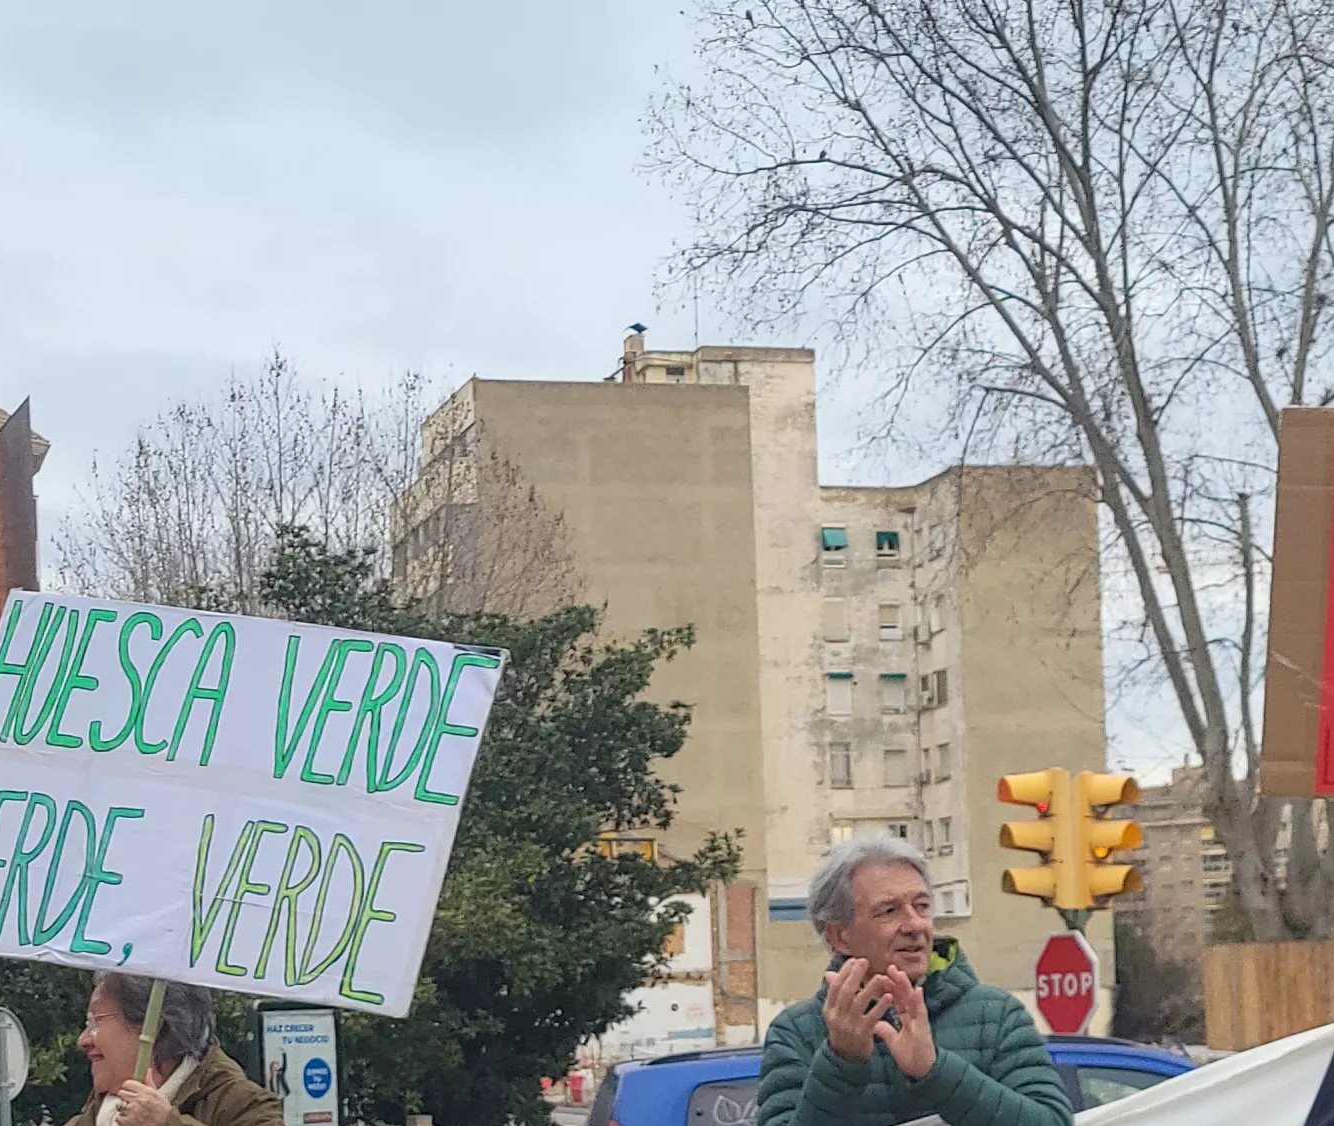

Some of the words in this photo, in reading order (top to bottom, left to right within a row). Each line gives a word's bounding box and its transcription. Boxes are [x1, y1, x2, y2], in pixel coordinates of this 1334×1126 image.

[273, 634, 502, 805] VERDE
[189, 813, 426, 1005] VERDE
[1038, 973, 1093, 998] STOP
